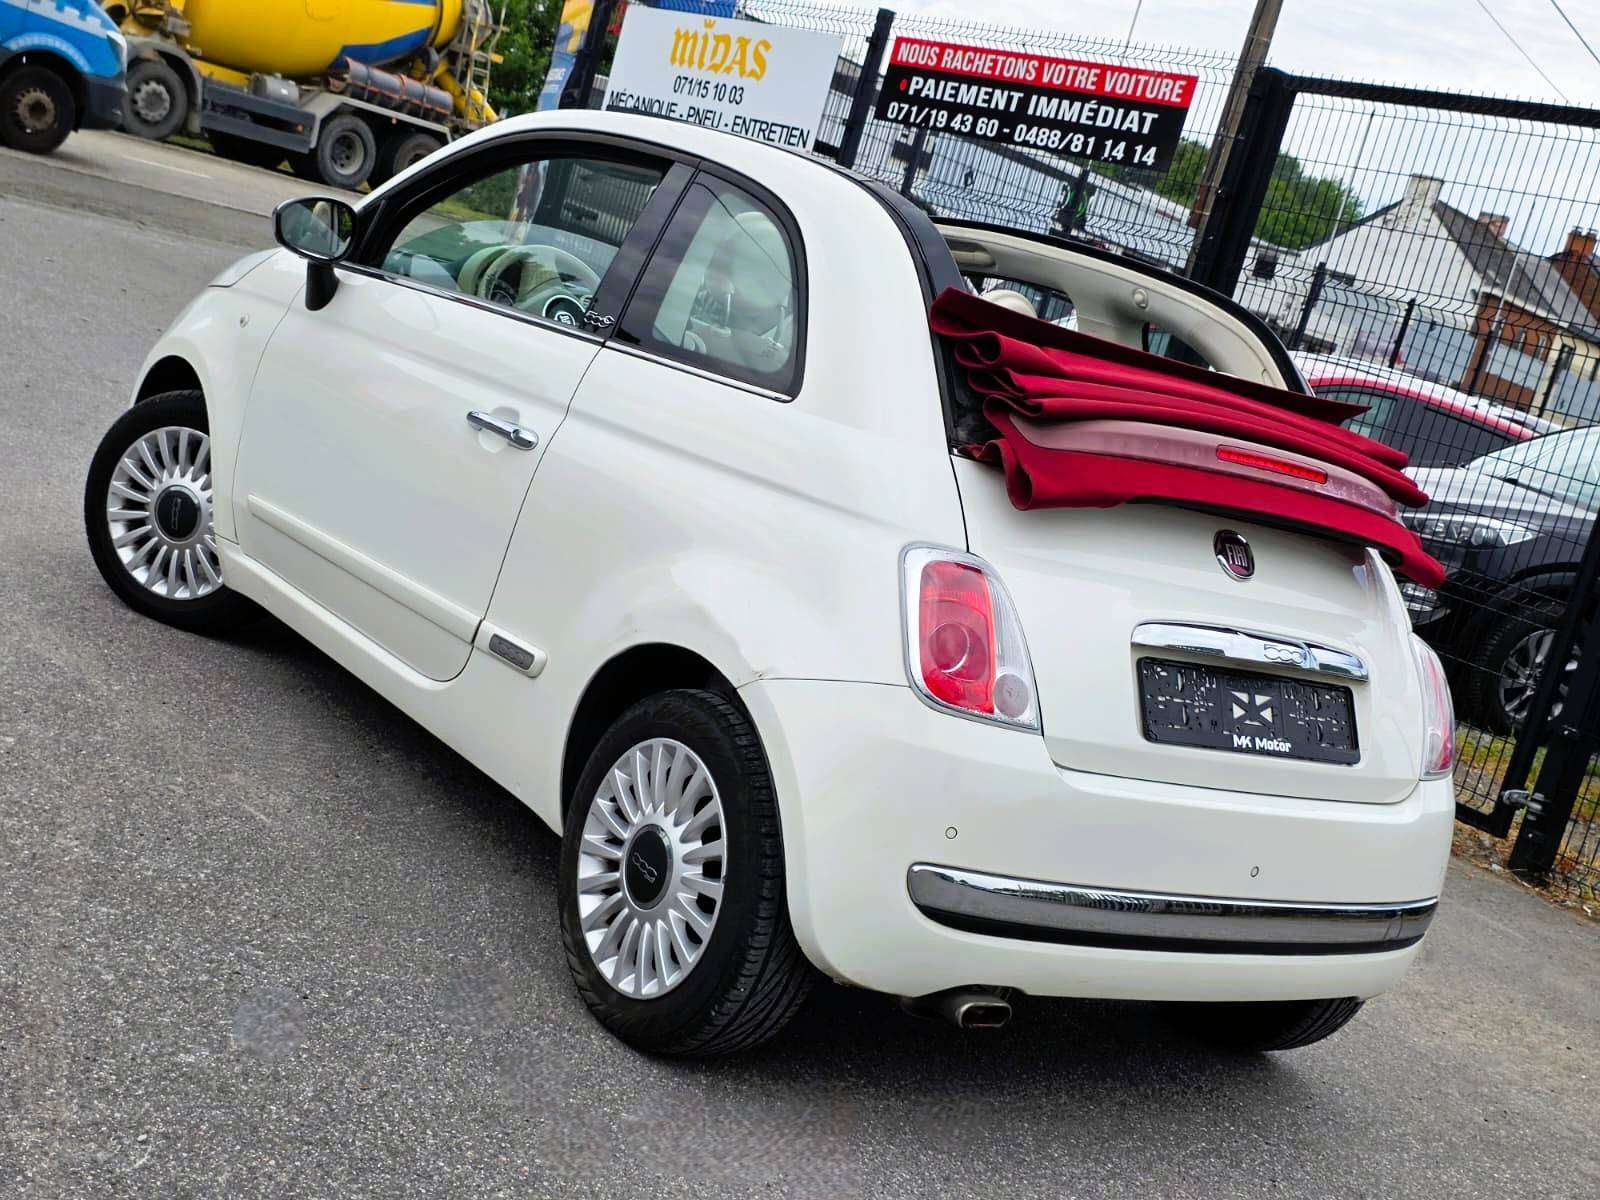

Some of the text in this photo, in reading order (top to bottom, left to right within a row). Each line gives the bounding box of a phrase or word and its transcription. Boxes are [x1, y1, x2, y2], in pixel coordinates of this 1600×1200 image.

[673, 75, 744, 105] 071/15 10 03
[898, 43, 1187, 102] NOUS RACHETONS VOTRE VOITURE
[908, 76, 1159, 134] PAIEMENT IMMÉDIAT
[731, 115, 810, 149] ENTRETIEN
[886, 102, 947, 128] 071/19
[950, 114, 972, 132] 43
[975, 118, 999, 137] 60
[1013, 124, 1095, 155] 0488/81
[1102, 139, 1125, 160] 14
[1133, 146, 1158, 166] 14
[1232, 734, 1293, 753] MK Motor
